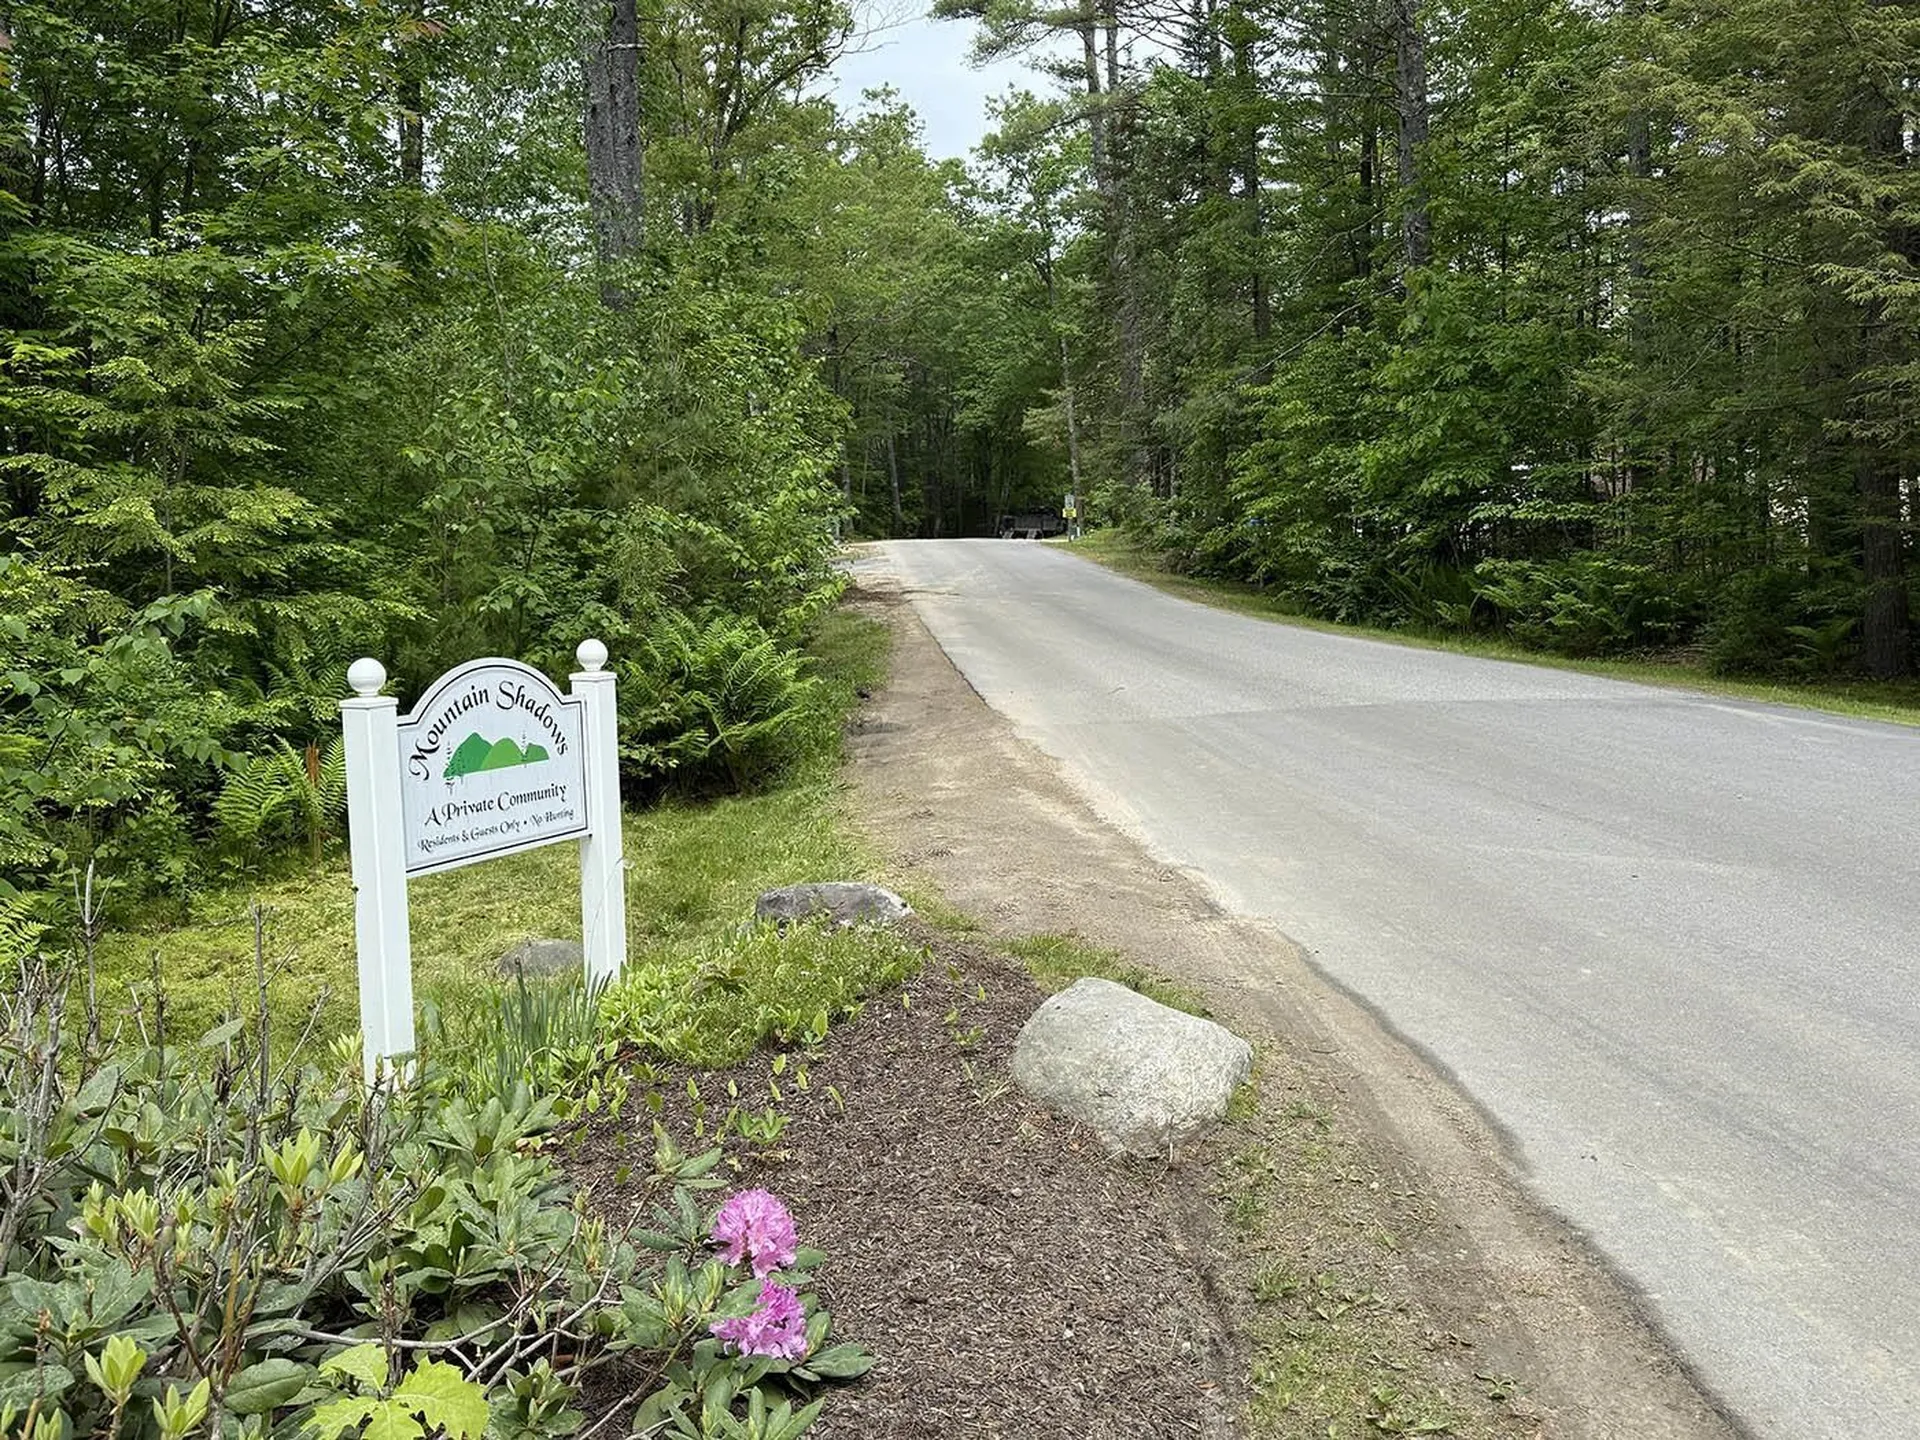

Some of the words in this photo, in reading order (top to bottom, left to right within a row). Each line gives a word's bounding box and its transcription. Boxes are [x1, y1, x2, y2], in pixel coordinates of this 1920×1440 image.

[408, 685, 490, 781] Mountain
[496, 680, 568, 756] Shadows
[424, 807, 441, 826] A
[442, 800, 494, 826] Private
[498, 783, 566, 811] Community
[417, 834, 460, 853] Residents
[461, 830, 469, 842] &
